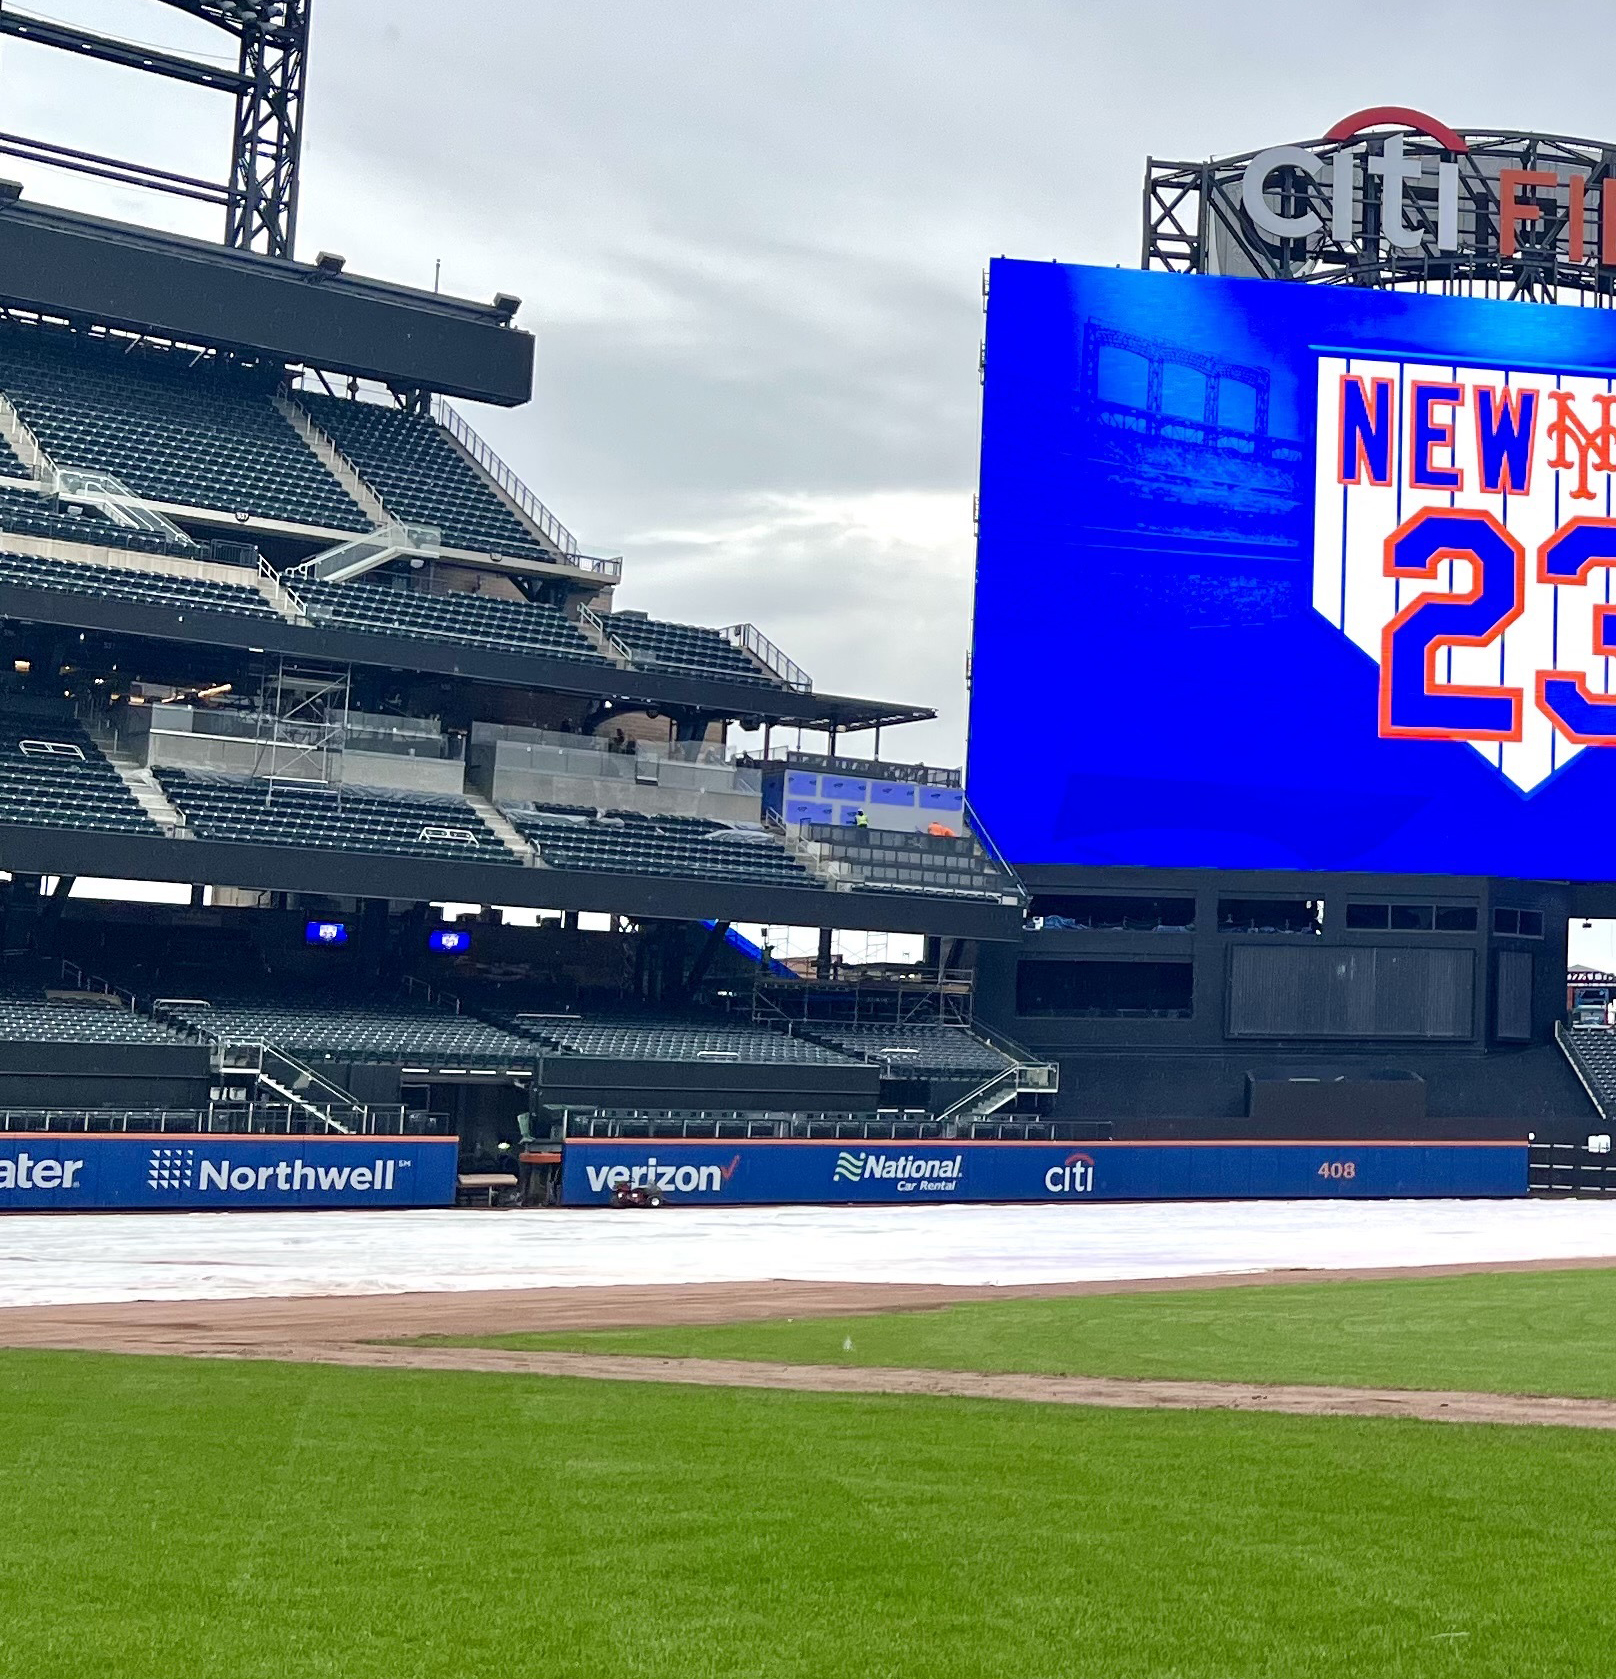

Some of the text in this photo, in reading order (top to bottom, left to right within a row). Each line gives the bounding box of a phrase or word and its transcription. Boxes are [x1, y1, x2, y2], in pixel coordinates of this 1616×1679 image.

[1241, 132, 1459, 251] citi
[1337, 373, 1540, 497] NEW
[199, 1159, 395, 1191] Northwell
[585, 1157, 722, 1192] verizon
[896, 1180, 957, 1192] Car Rental
[1044, 1160, 1094, 1192] citi
[1317, 1161, 1356, 1179] 408
